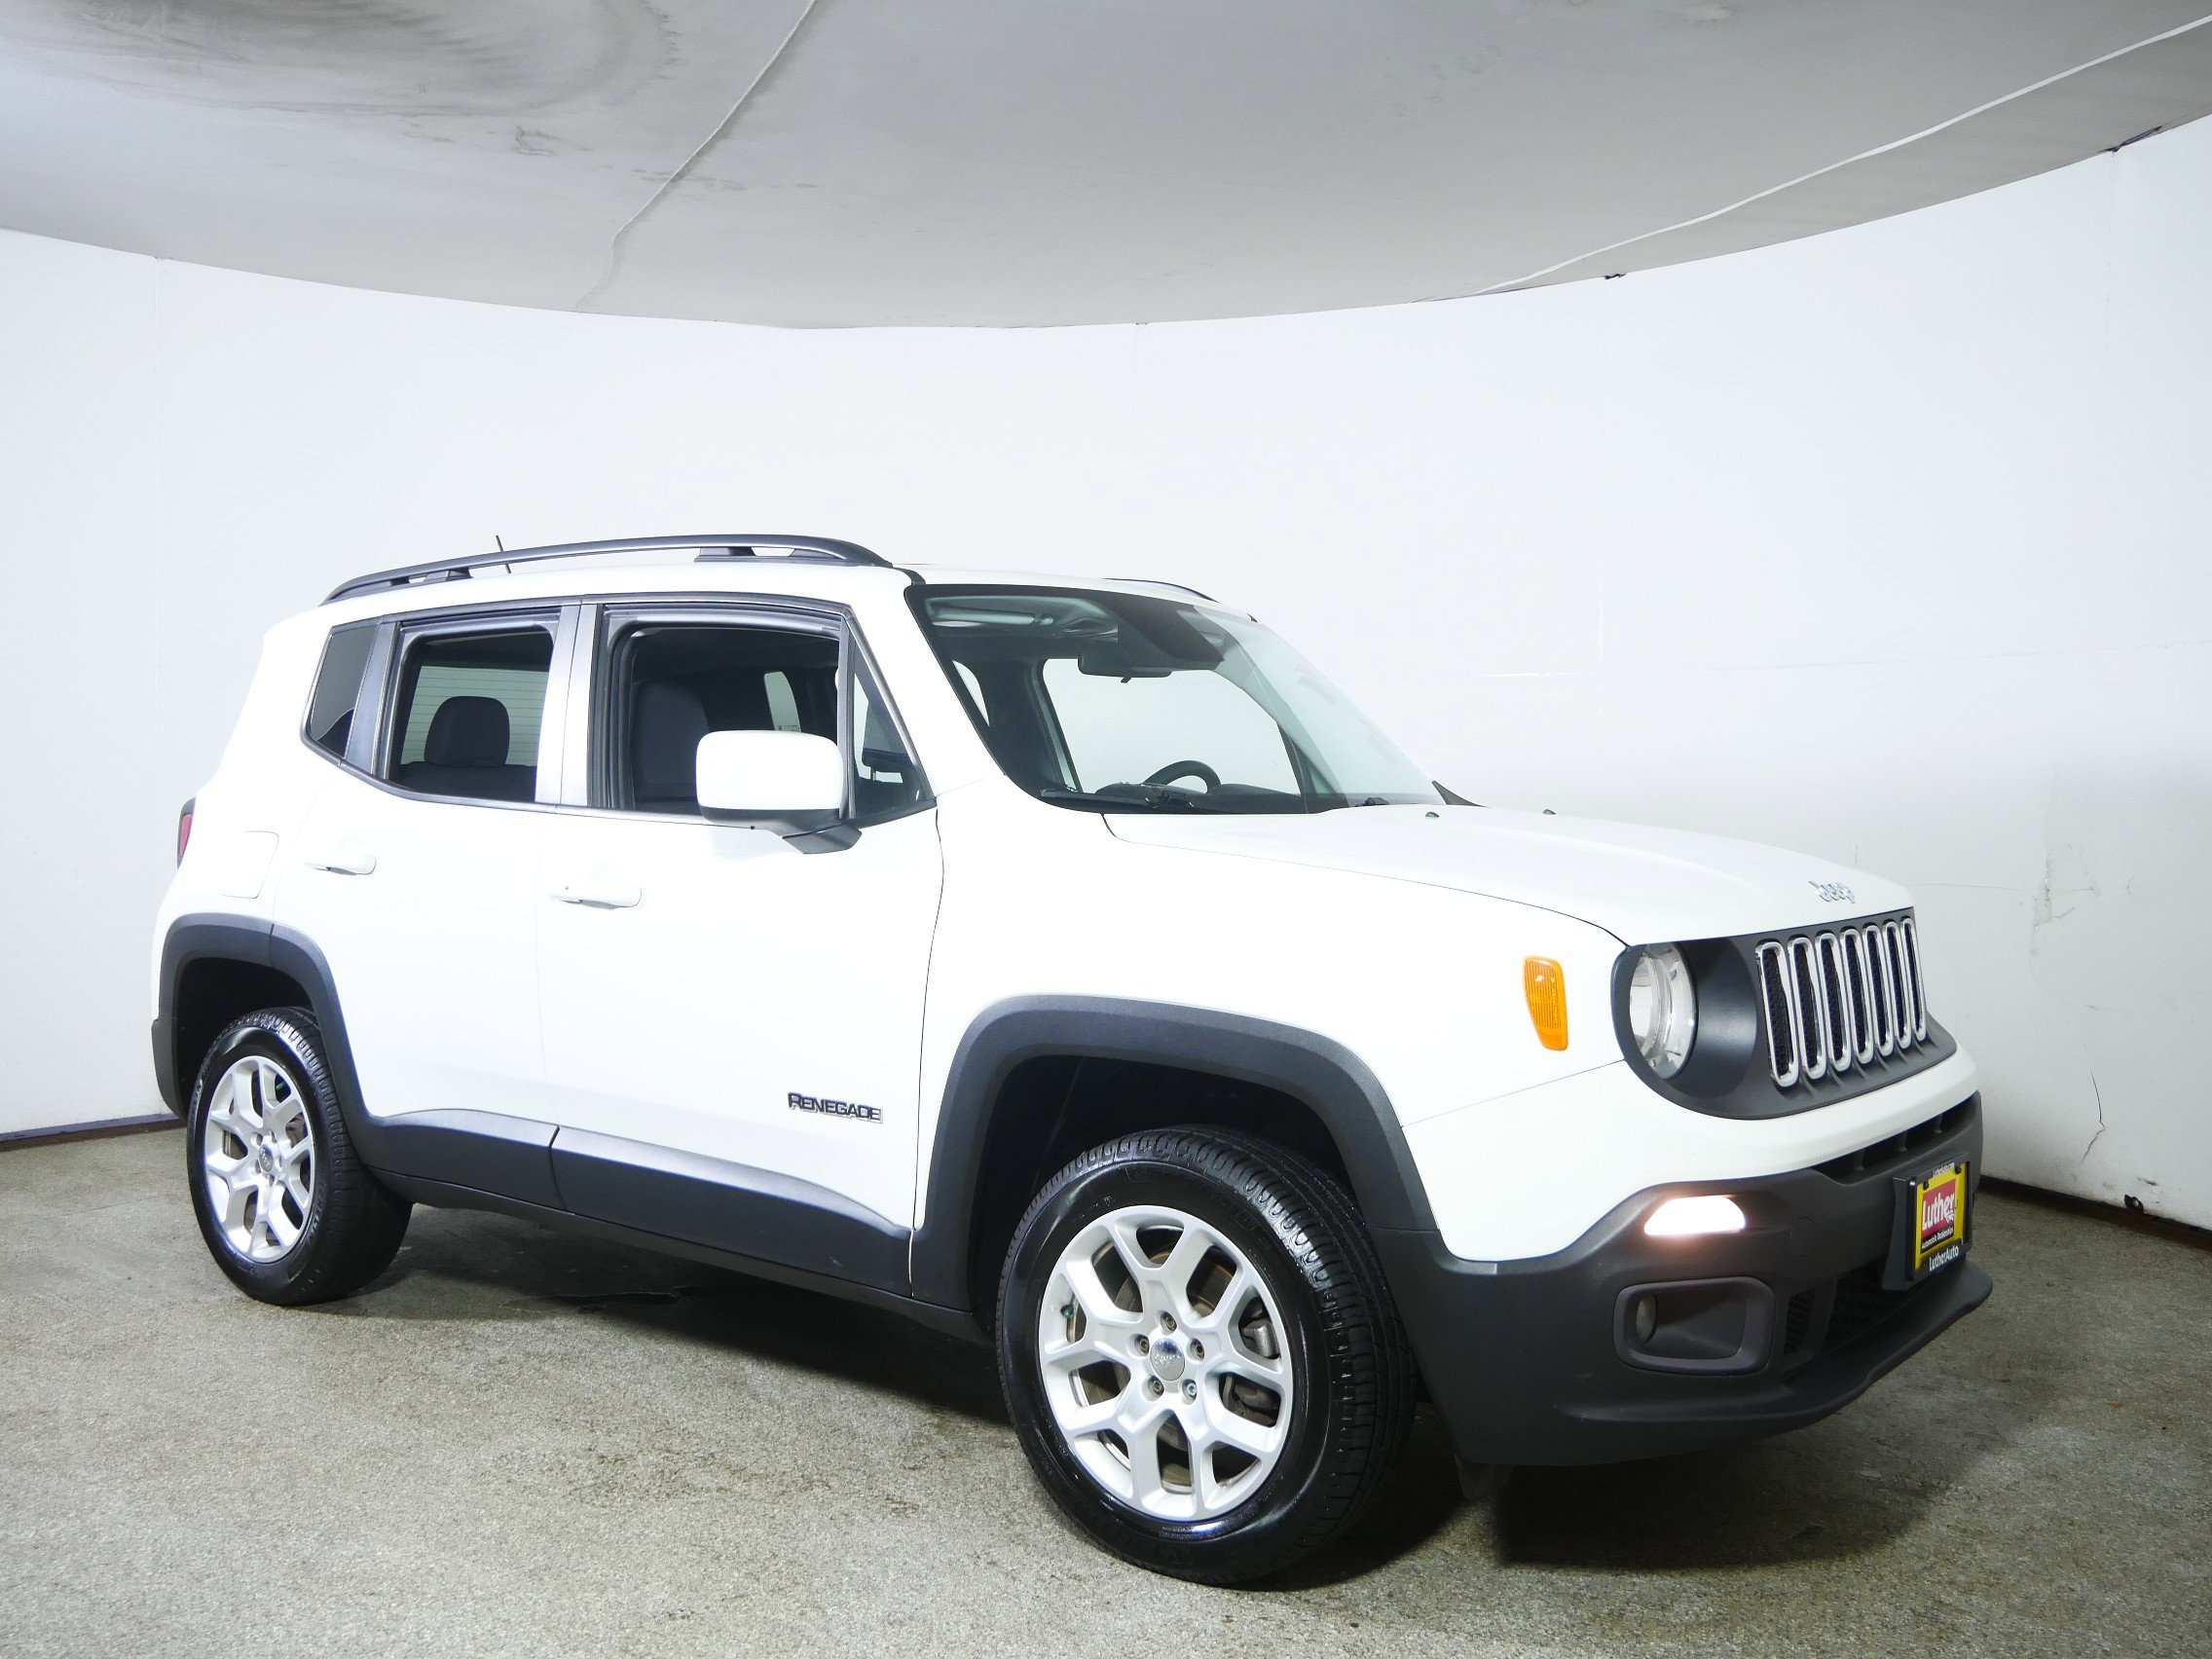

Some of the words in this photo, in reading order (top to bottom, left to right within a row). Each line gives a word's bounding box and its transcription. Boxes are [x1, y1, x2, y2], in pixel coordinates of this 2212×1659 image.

[1808, 879, 1856, 904] Jeep
[788, 1091, 882, 1123] RENEGADE
[1922, 1193, 1955, 1231] Luther
[1929, 1244, 1959, 1272] LutherAuto
